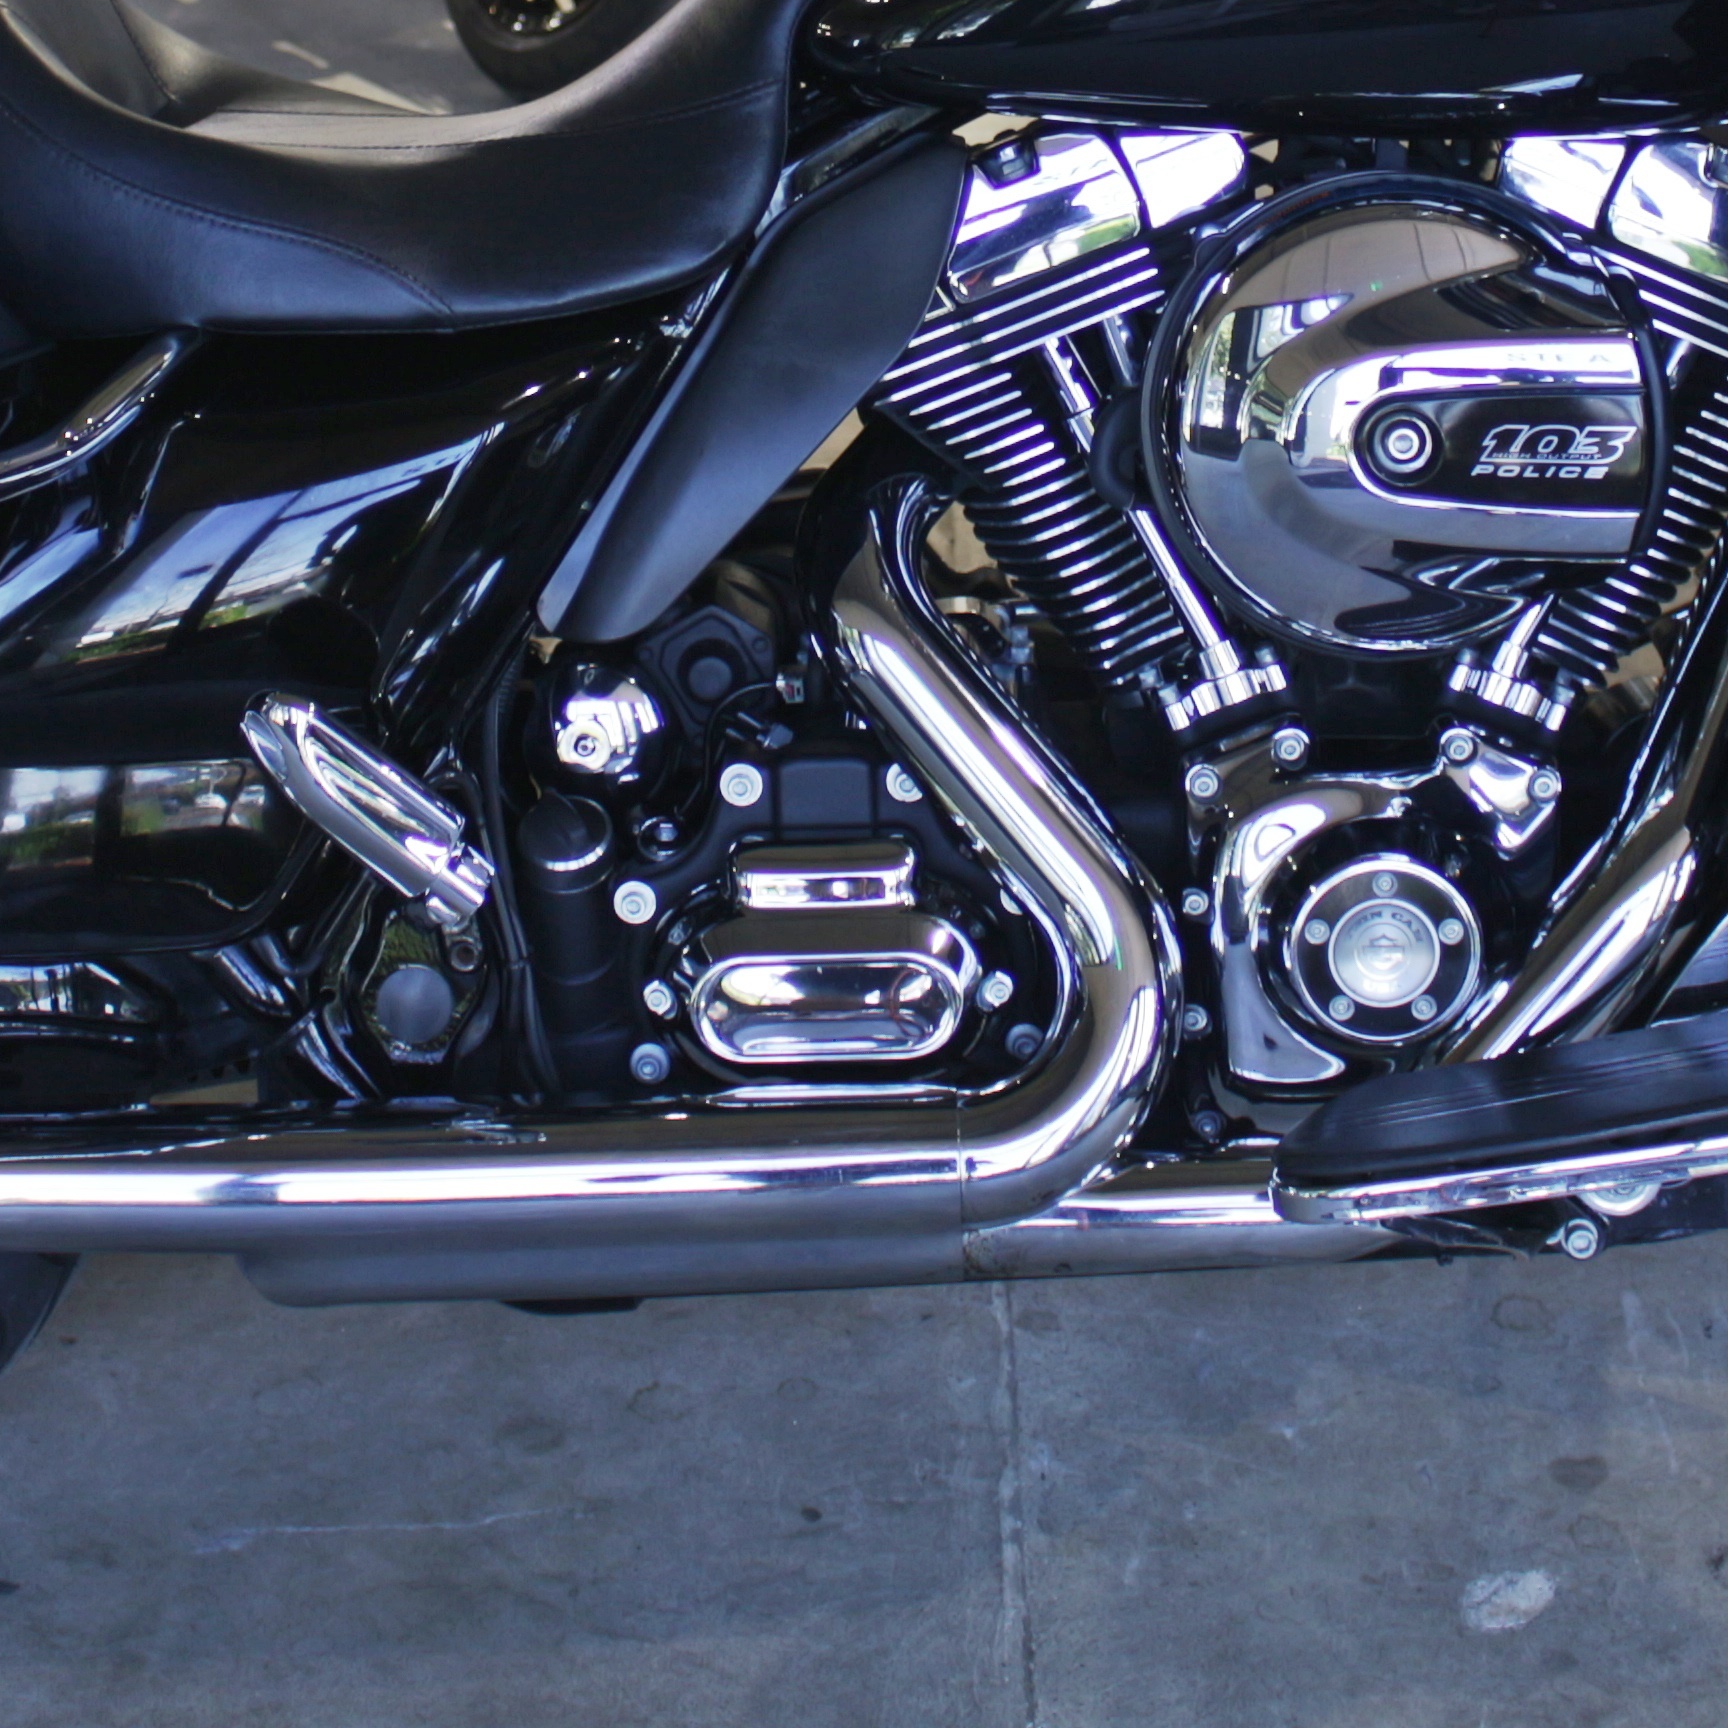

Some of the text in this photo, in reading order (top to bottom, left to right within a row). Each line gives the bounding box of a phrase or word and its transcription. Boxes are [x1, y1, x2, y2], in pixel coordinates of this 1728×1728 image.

[1480, 424, 1638, 465] 103
[1491, 451, 1603, 461] HIGH OUTPUT
[1470, 464, 1610, 479] POLICE
